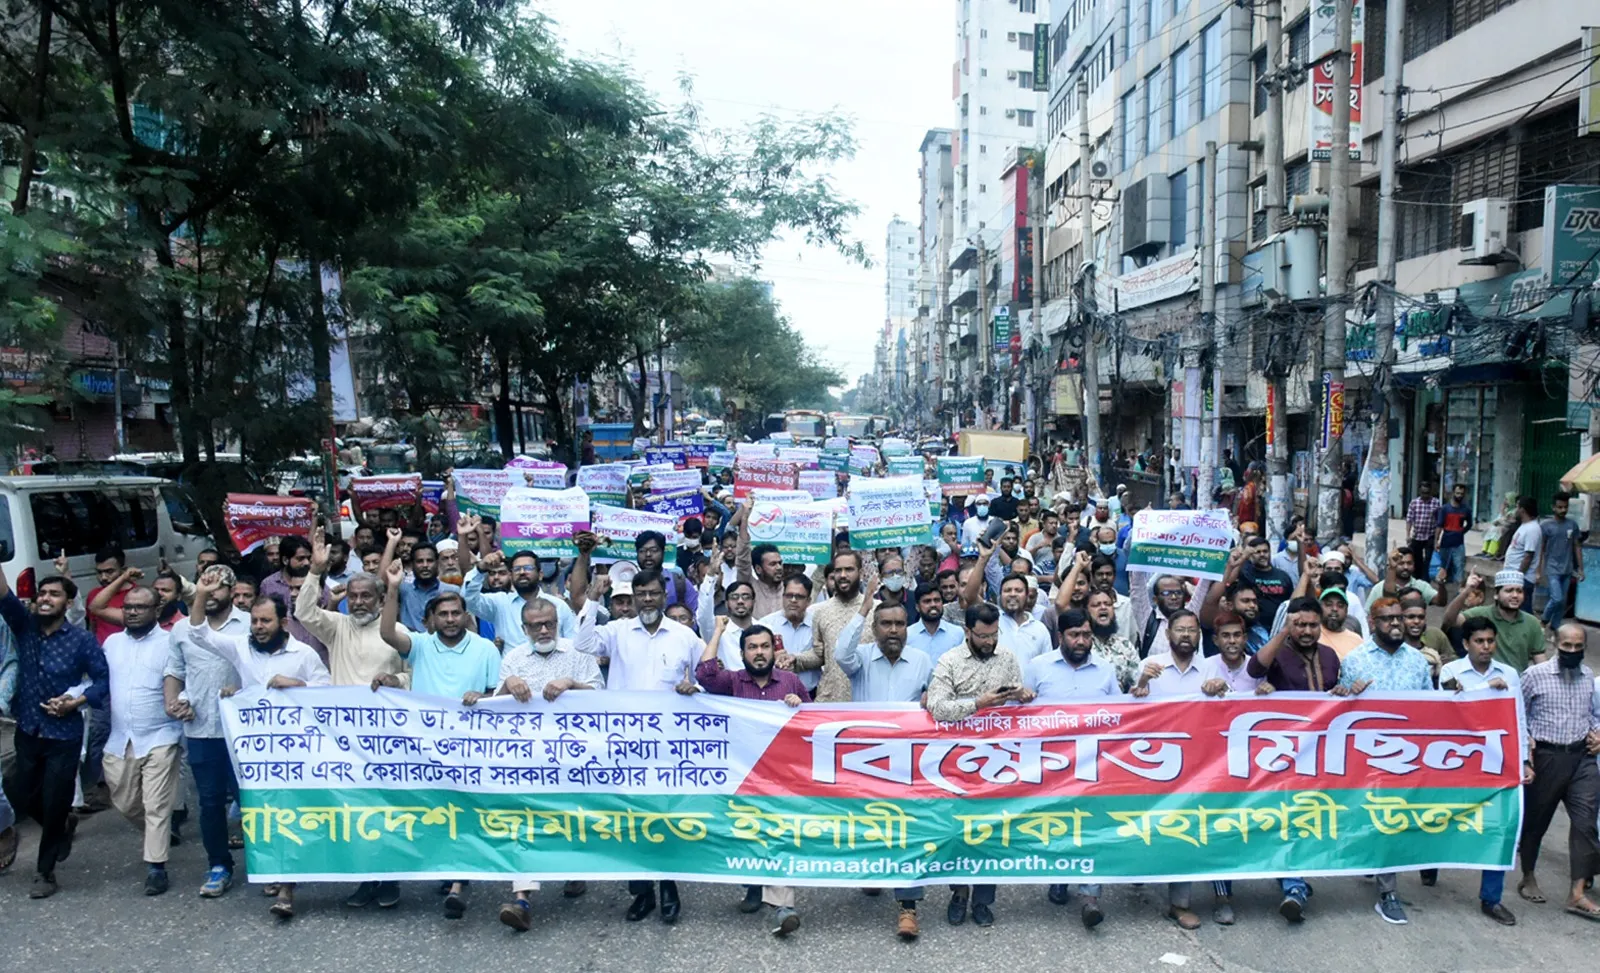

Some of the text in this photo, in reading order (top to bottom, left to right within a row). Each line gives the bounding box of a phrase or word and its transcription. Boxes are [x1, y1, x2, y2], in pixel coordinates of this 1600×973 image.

[517, 523, 573, 537] মুক্তি চাই
[239, 698, 303, 727] আমীরে
[312, 705, 409, 728] জামায়াত
[554, 710, 663, 733] রহমানসহ
[672, 712, 730, 733] সকল
[1016, 711, 1079, 730] রাহমানির
[1083, 709, 1122, 727] রাহিম
[234, 725, 325, 754] নেতাকর্মী
[335, 735, 350, 751] ও
[357, 735, 535, 759] আলেম-ওলামাদের
[606, 733, 660, 760] মিথ্যা
[667, 738, 730, 759] মামলা
[801, 710, 1509, 796] বিক্ষোভ মিছিল
[312, 761, 355, 783] এবং
[364, 757, 483, 785] কেয়ারটেকার
[488, 764, 561, 785] সরকার
[568, 759, 648, 786] প্রতিষ্ঠার
[655, 760, 729, 787] দাবিতে
[240, 802, 463, 846] বাংলাদেশ
[473, 804, 713, 843] জামায়াতে
[952, 808, 1094, 848] ঢাকা
[1106, 791, 1349, 848] মহানগরী
[1360, 791, 1493, 835] উত্তর
[725, 855, 1095, 875] www.jamaatdhakacitynorth.org
